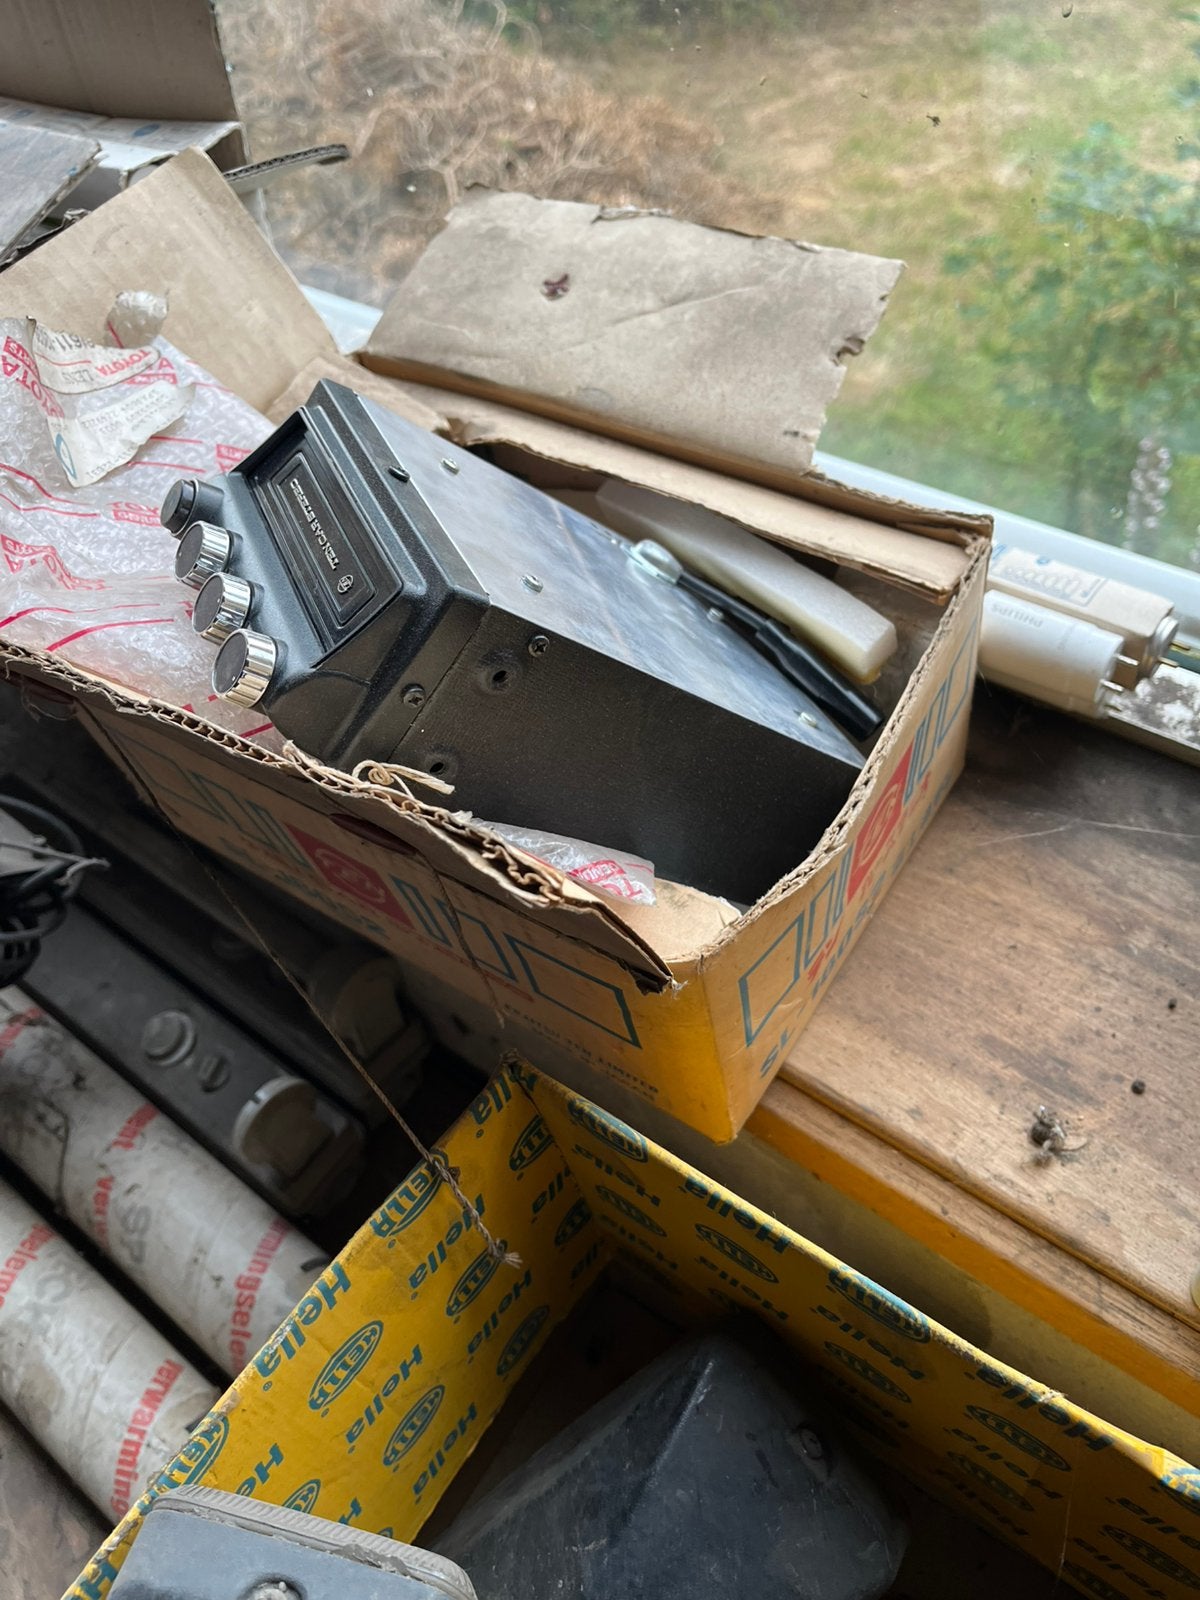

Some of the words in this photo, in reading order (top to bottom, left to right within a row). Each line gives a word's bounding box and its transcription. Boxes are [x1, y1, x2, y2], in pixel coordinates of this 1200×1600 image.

[95, 350, 149, 376] TOYOTA
[290, 478, 315, 522] STEREO
[310, 519, 328, 546] CAR
[322, 542, 340, 570] TEN
[574, 1145, 660, 1206] Hella
[601, 1213, 679, 1271] Hella
[685, 1175, 790, 1254] Hella
[446, 1246, 507, 1317] ELLA
[467, 1268, 532, 1354] Hella
[699, 1255, 788, 1320] Hella
[253, 1262, 351, 1378] Hella
[816, 1304, 925, 1380] Hella
[308, 1321, 384, 1410] HELLA
[346, 1344, 423, 1443] Hella
[383, 1385, 445, 1466] HELLA
[975, 1365, 1113, 1451] Hella
[411, 1402, 478, 1494] Hella
[951, 1429, 1064, 1500] Hella
